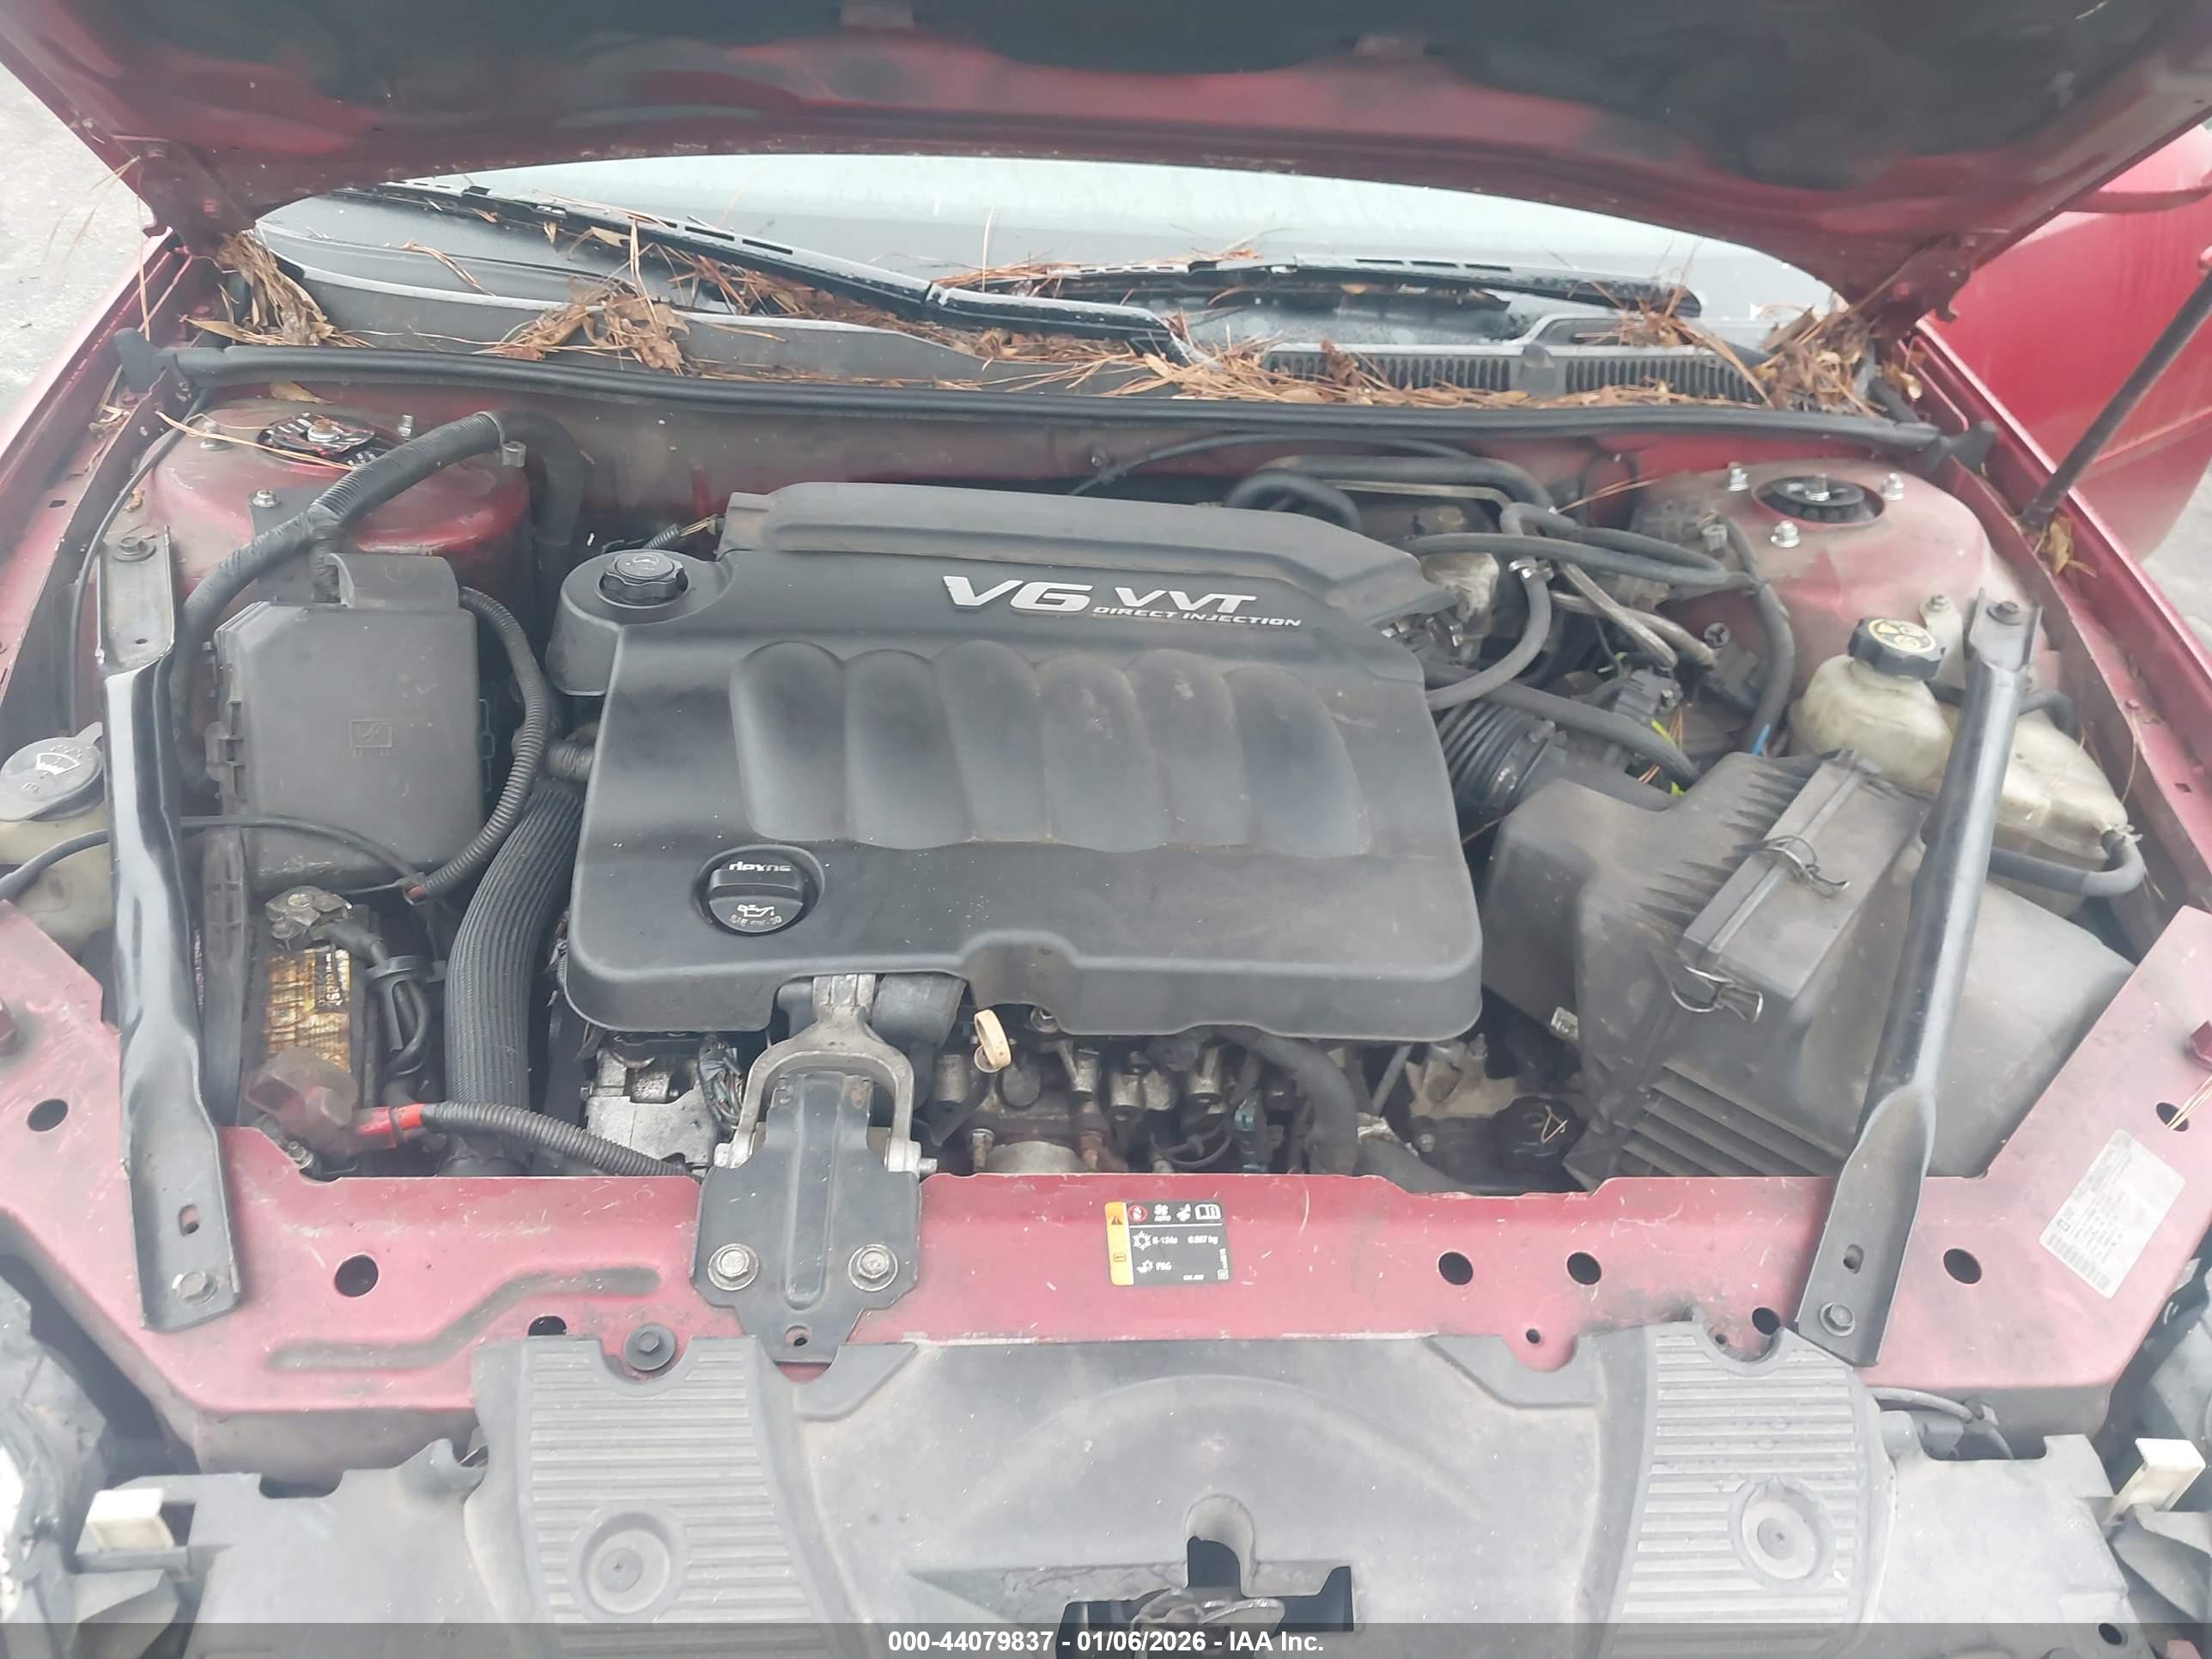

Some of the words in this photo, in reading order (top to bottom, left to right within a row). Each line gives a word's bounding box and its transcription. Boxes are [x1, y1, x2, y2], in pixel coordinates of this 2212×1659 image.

[942, 575, 1094, 612] V6
[1114, 586, 1258, 614] VVT
[1092, 606, 1178, 618] DIRECT
[1182, 612, 1303, 627] INJECTION
[1155, 1261, 1173, 1271] PAG
